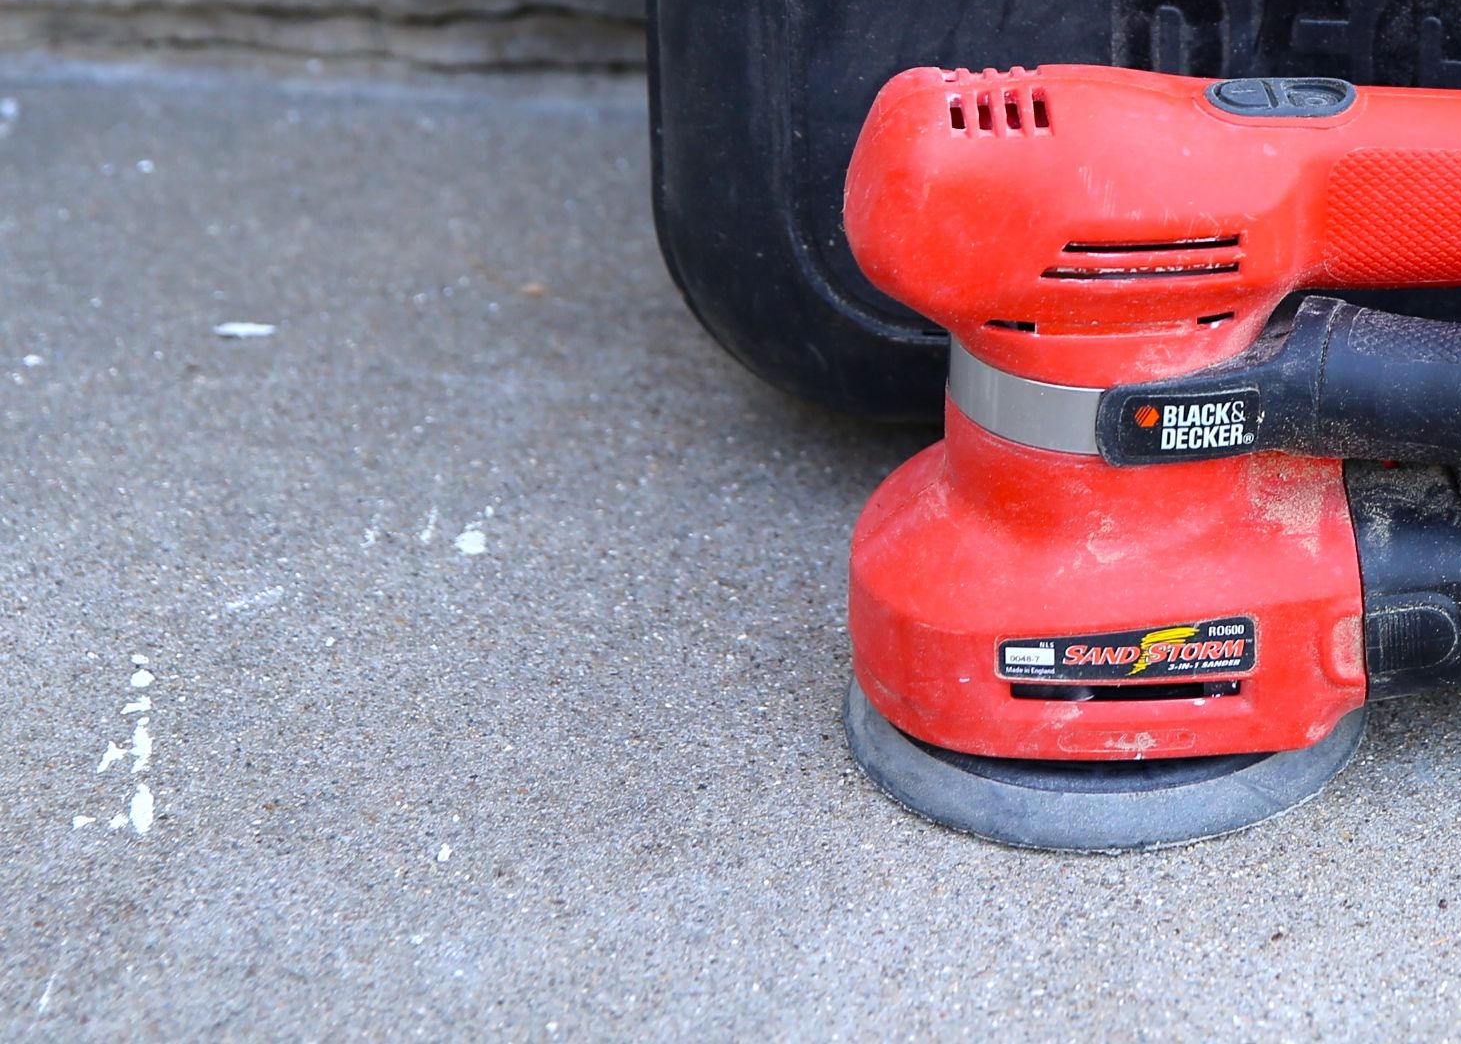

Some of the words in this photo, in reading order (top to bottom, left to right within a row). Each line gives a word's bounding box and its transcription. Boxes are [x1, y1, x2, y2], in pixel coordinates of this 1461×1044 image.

[1062, 644, 1141, 665] SAND
[1005, 666, 1024, 674] Made
[1031, 667, 1056, 675] England
